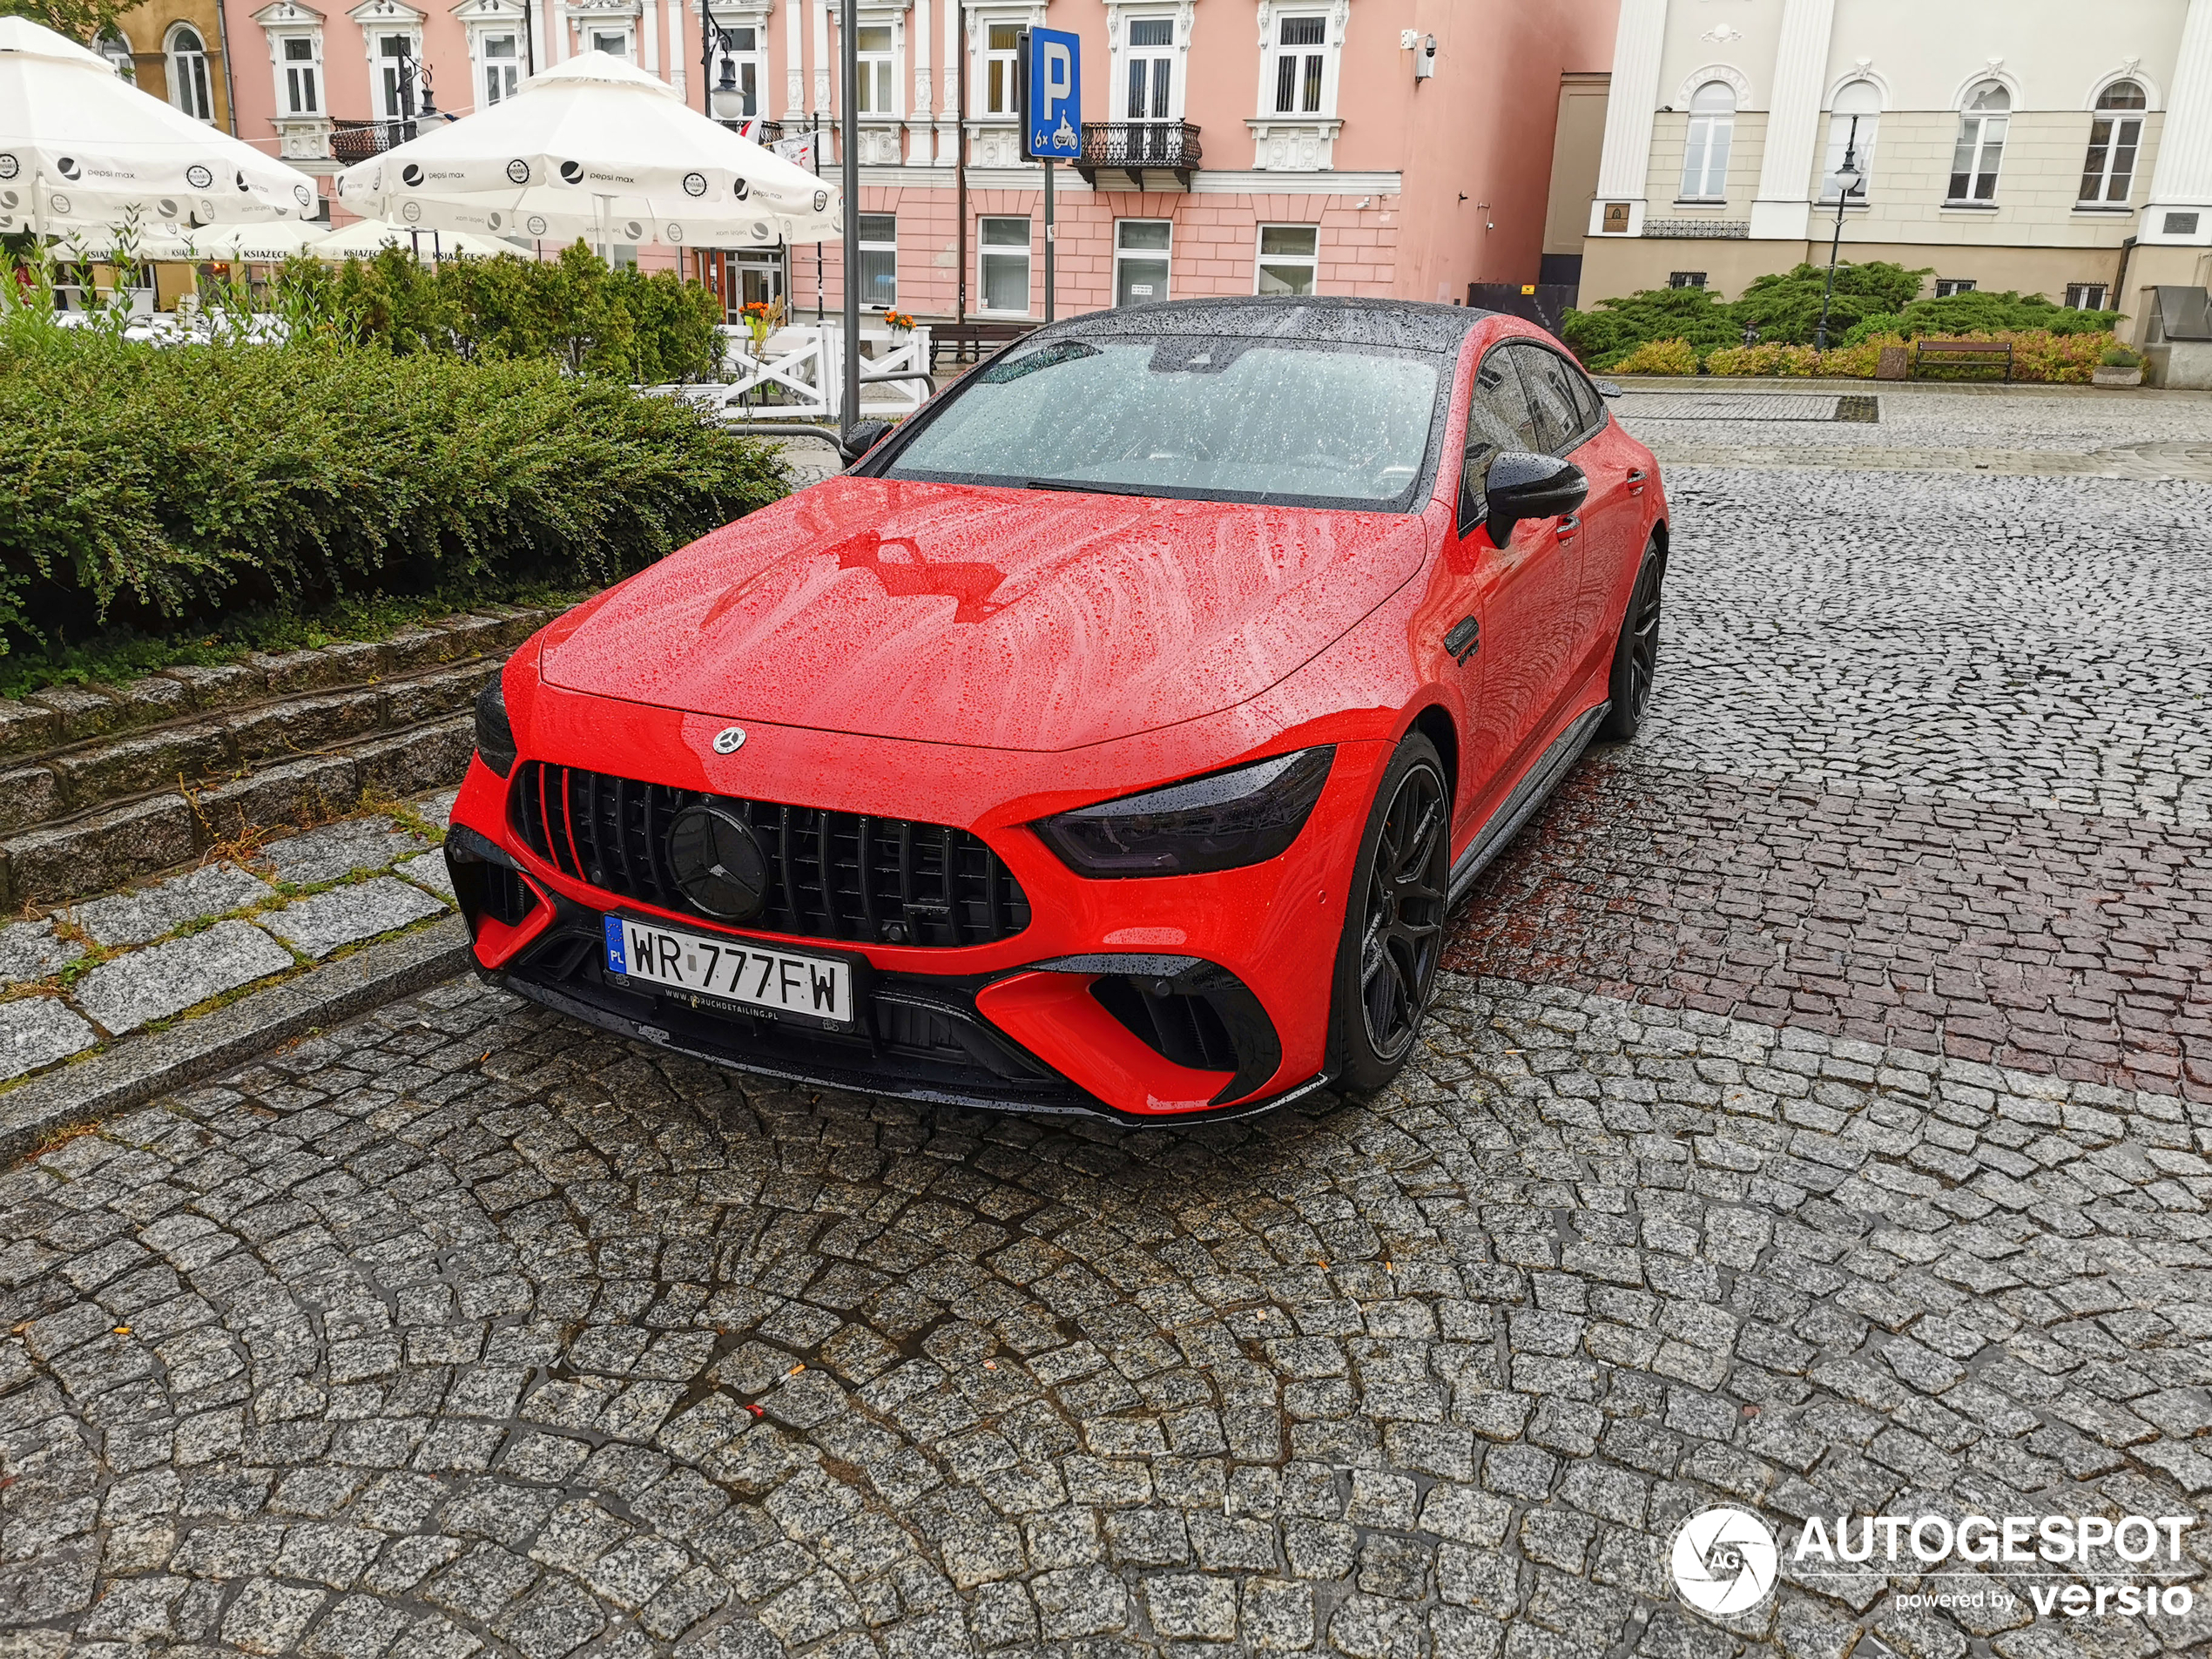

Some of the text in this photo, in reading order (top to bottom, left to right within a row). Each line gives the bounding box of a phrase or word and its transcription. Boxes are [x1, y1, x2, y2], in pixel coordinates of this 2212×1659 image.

[1043, 41, 1071, 120] P
[1035, 129, 1048, 148] 6x
[87, 169, 113, 178] pepsi
[590, 172, 614, 181] pepsi
[610, 950, 624, 965] PL
[631, 928, 835, 1013] WR 777FW
